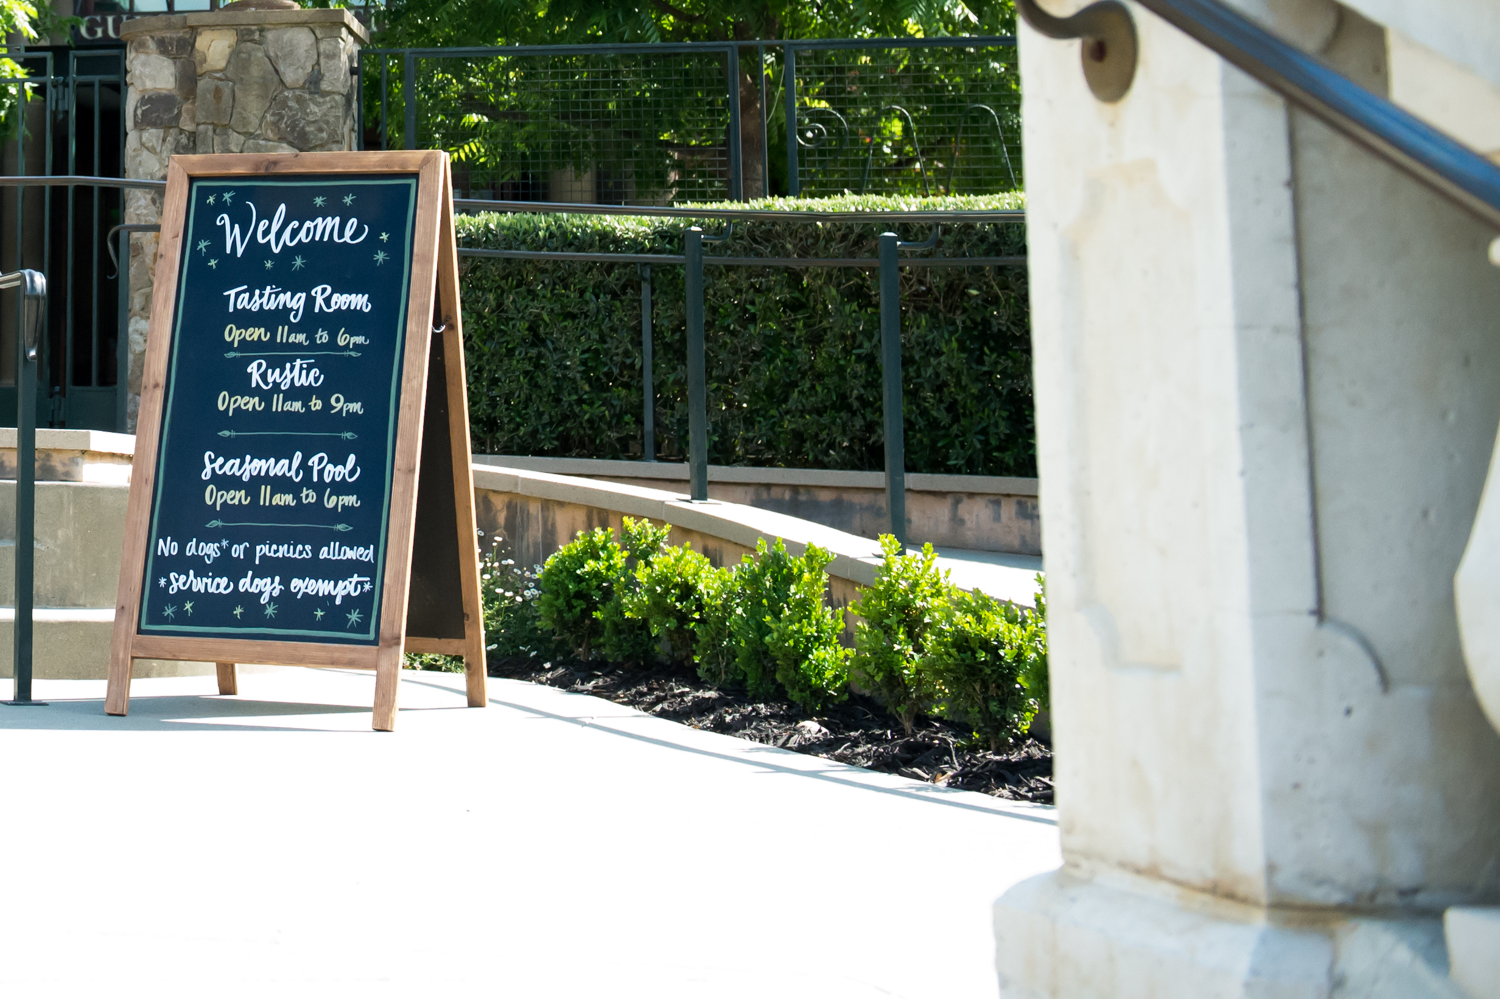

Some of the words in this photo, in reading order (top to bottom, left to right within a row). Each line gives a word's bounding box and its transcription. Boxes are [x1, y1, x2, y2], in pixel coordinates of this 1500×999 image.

[216, 201, 369, 258] Welcome
[223, 285, 307, 323] Tasting
[310, 284, 372, 313] Room
[224, 323, 271, 348] Open
[276, 325, 310, 346] 11am
[314, 328, 329, 344] to
[337, 327, 370, 349] 6pm
[246, 359, 325, 391] Rustic
[217, 391, 265, 417] Open
[272, 393, 306, 414] 11am
[308, 395, 323, 412] to
[330, 393, 364, 417] 9pm
[201, 451, 304, 483] Seasonal
[307, 452, 361, 484] Pool
[204, 484, 251, 511] Open
[259, 484, 297, 507] 11am
[299, 486, 317, 504] to
[323, 487, 361, 513] 6pm
[157, 536, 179, 558] No
[231, 541, 250, 560] or
[254, 540, 313, 565] picnics
[318, 541, 375, 564] allowed
[238, 570, 285, 605] dogs
